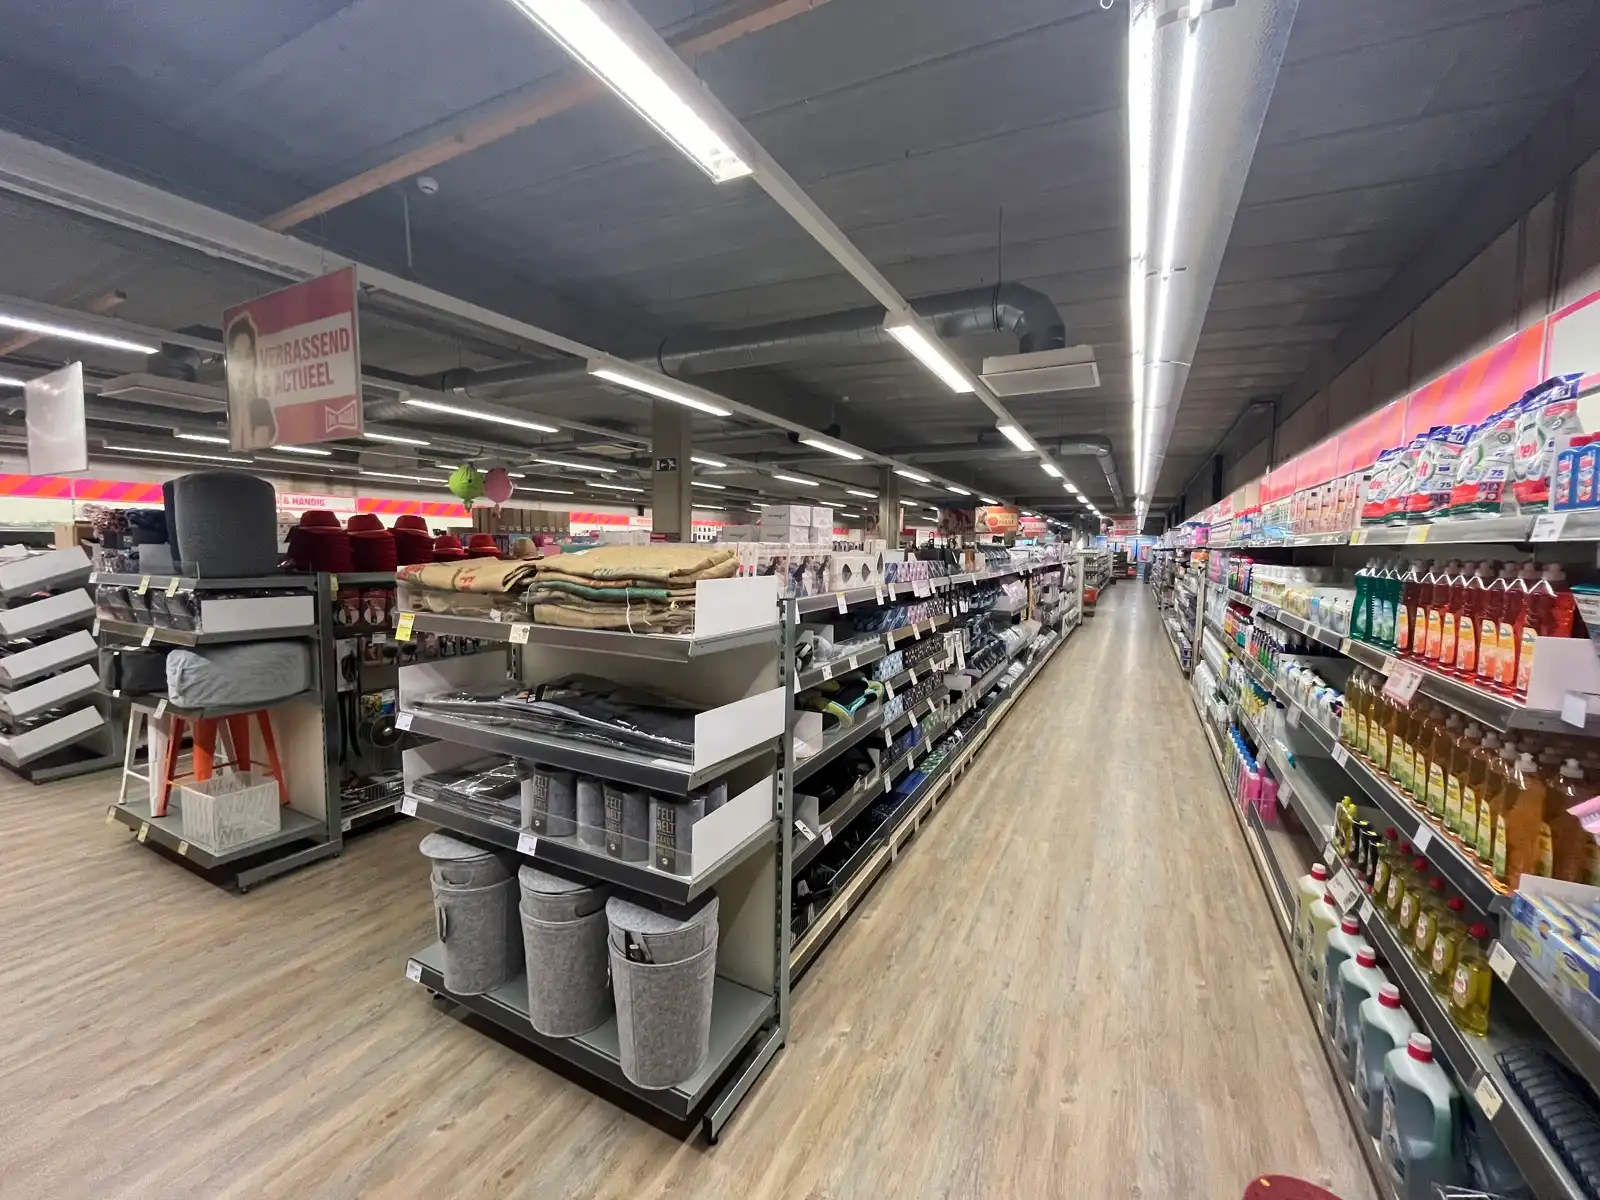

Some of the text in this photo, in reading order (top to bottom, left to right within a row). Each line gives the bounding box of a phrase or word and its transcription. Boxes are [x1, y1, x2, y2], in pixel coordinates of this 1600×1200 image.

[261, 327, 350, 369] VERRASSEND
[275, 361, 334, 395] ACTUEEL
[292, 497, 325, 507] HANDIG
[606, 808, 621, 822] BELT
[657, 806, 675, 822] FELT
[657, 820, 675, 834] BELT
